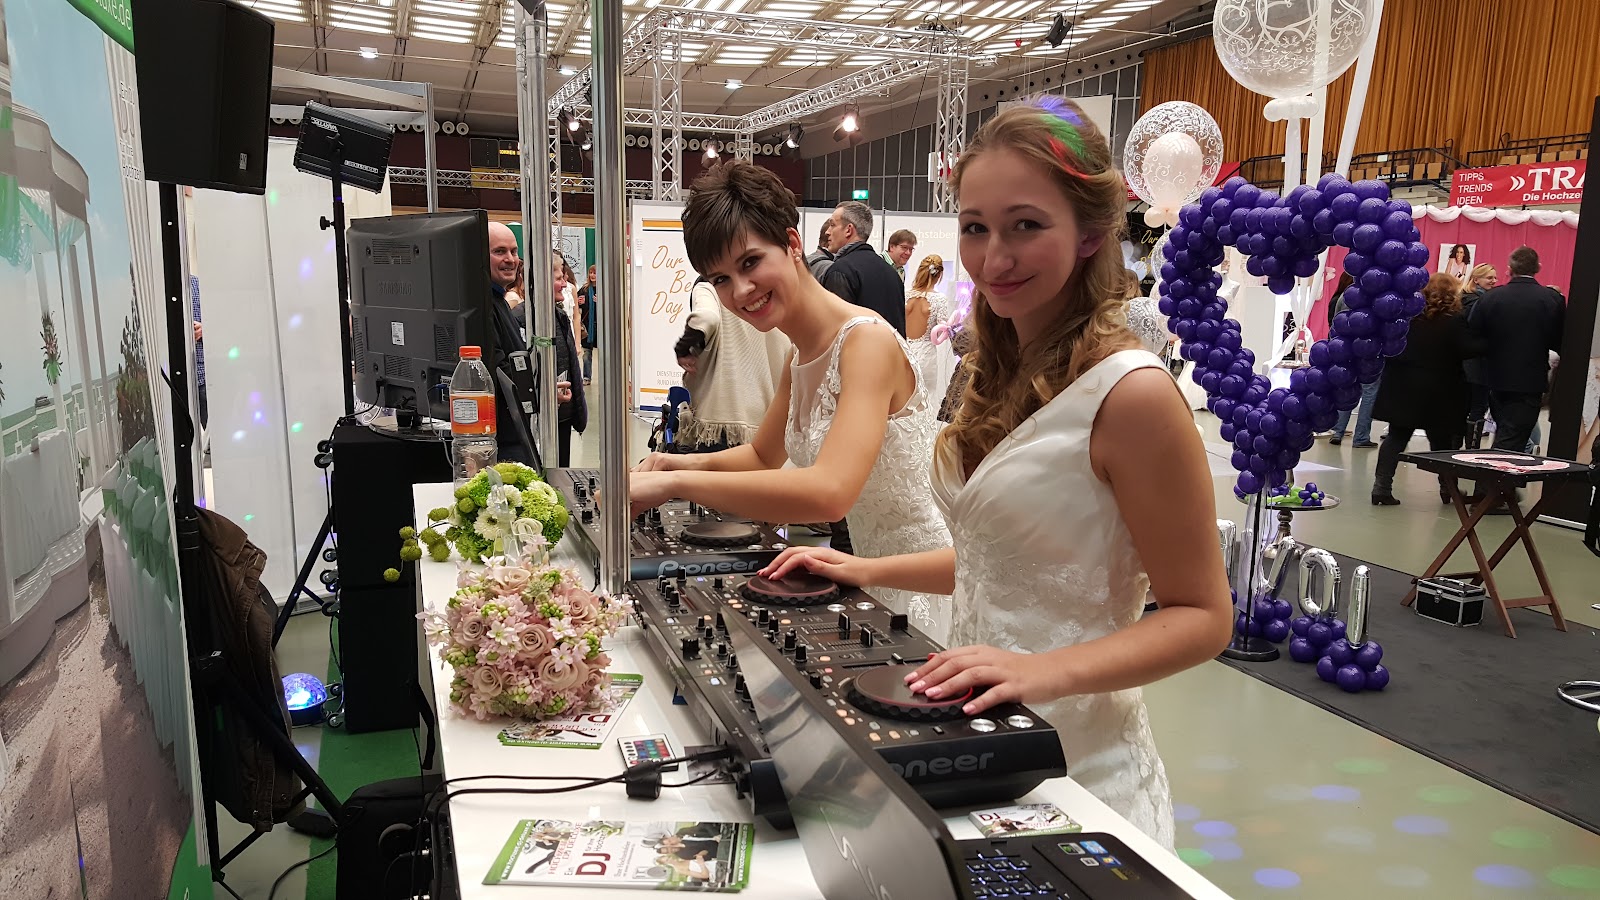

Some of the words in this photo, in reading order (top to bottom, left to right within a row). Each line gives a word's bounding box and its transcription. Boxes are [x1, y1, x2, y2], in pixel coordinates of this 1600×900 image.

[1459, 173, 1484, 182] TIPPS
[1458, 183, 1493, 193] TRENDS
[1457, 196, 1483, 205] IDEEN
[1522, 192, 1540, 202] Die
[1542, 190, 1583, 201] Hochzei
[652, 245, 684, 270] Our
[669, 269, 693, 294] Be
[650, 291, 684, 324] Day
[656, 370, 683, 378] DIENSTLEIST
[657, 560, 759, 577] Poneer
[978, 812, 1001, 821] DJ
[575, 853, 611, 876] DJ
[564, 866, 575, 876] Ein
